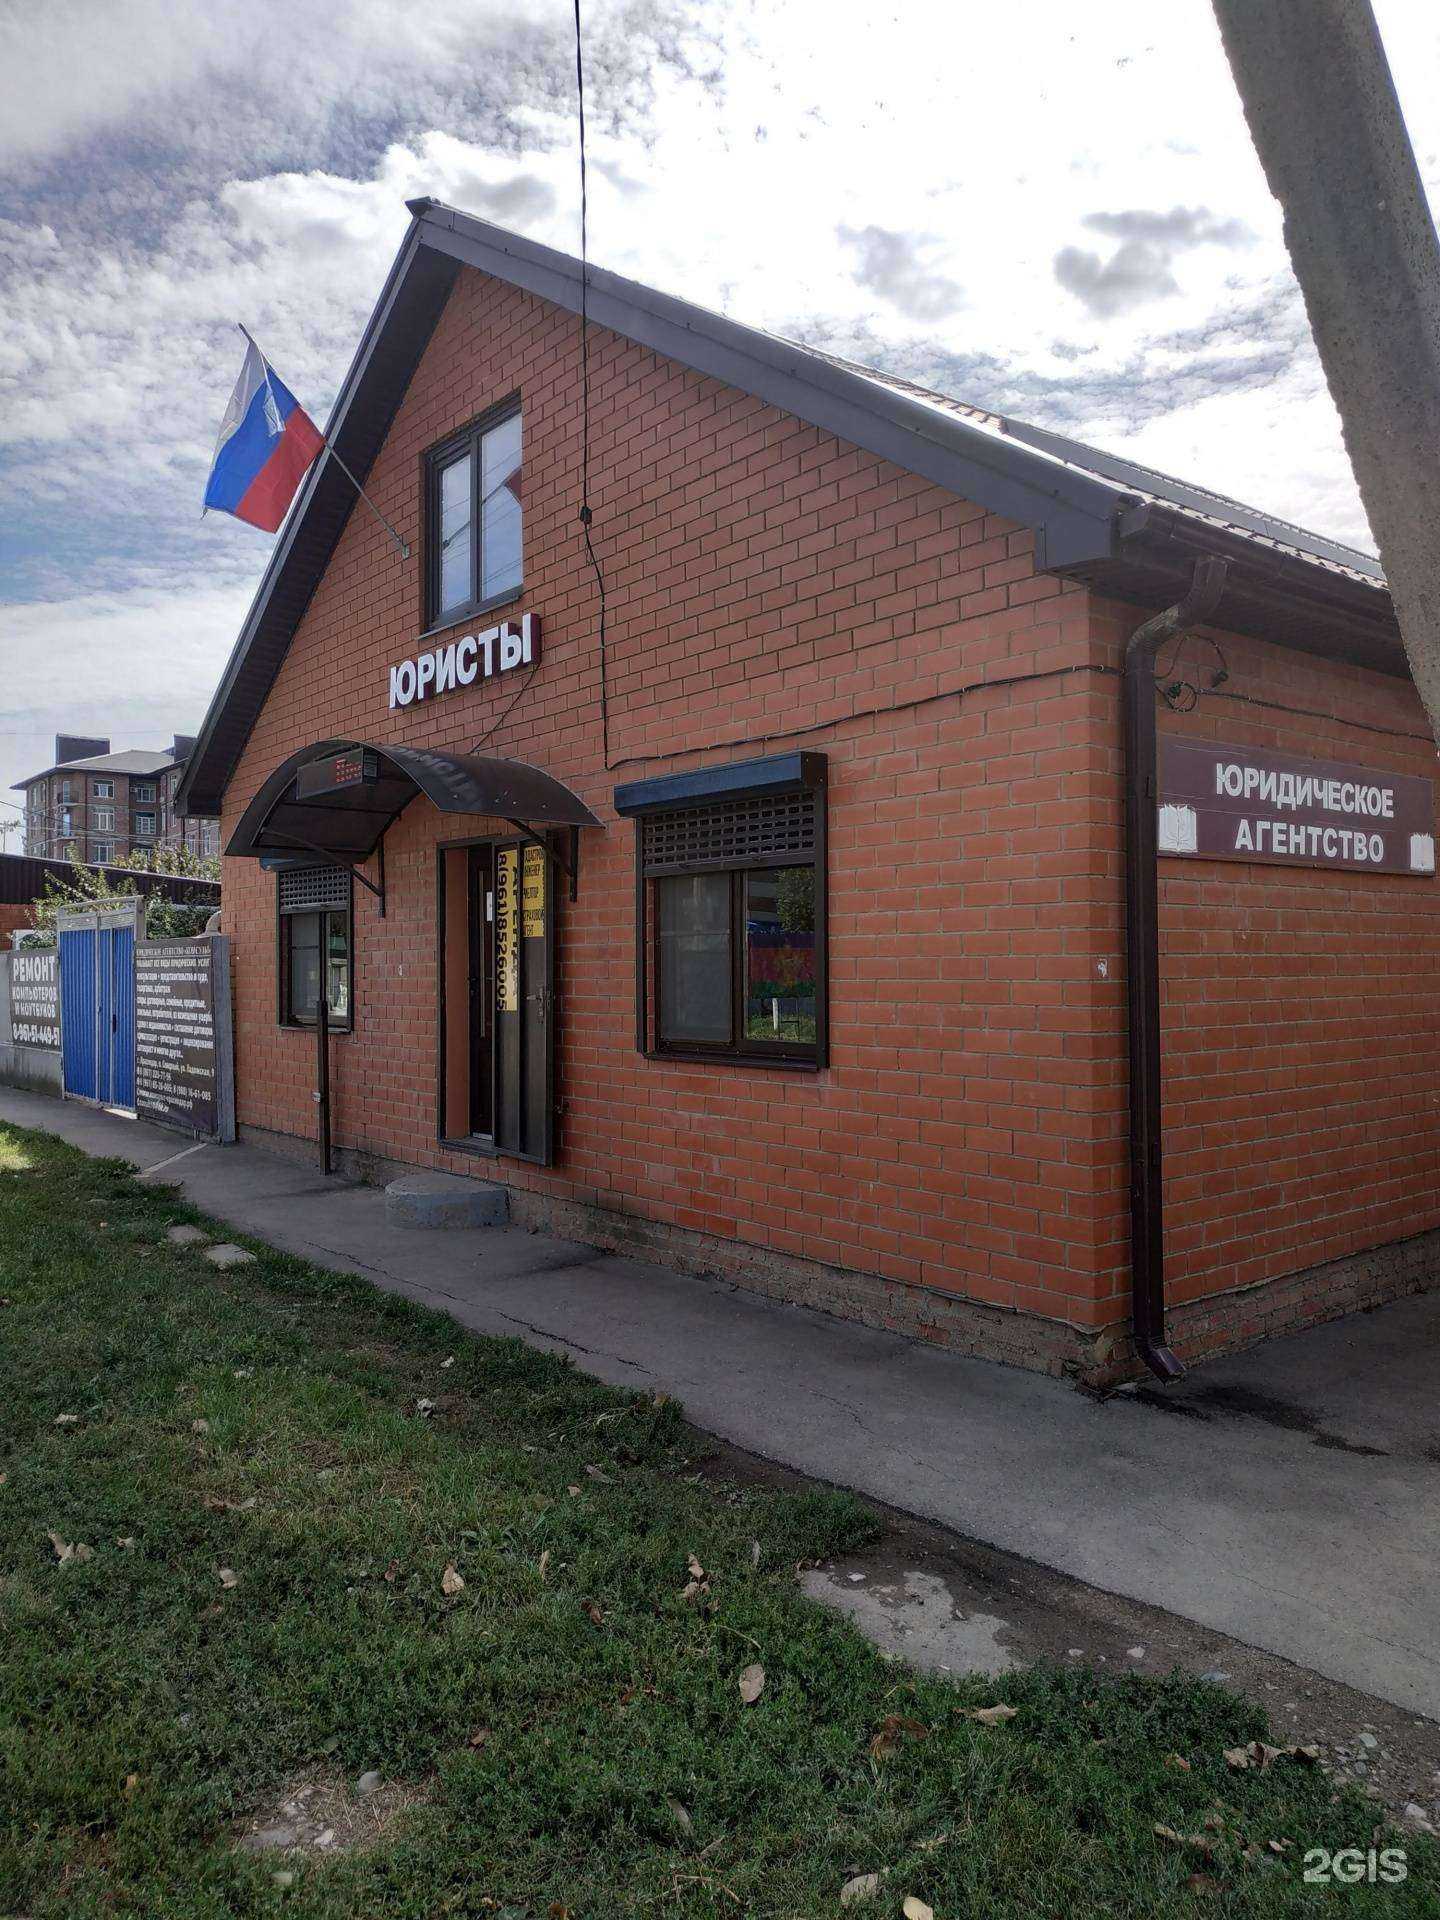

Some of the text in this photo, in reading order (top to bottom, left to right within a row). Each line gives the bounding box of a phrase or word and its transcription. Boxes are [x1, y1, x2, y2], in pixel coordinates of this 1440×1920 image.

[389, 612, 532, 709] ЮРИСТЫ
[1216, 763, 1395, 818] ЮРИДИЧЕСКОЕ
[1235, 819, 1384, 863] АГЕНТСТВО
[13, 956, 55, 982] РЕМОНТ
[12, 986, 57, 1002] КОМПЬЮТЕРОВ
[15, 1002, 56, 1018] И НОУТБУКОВ
